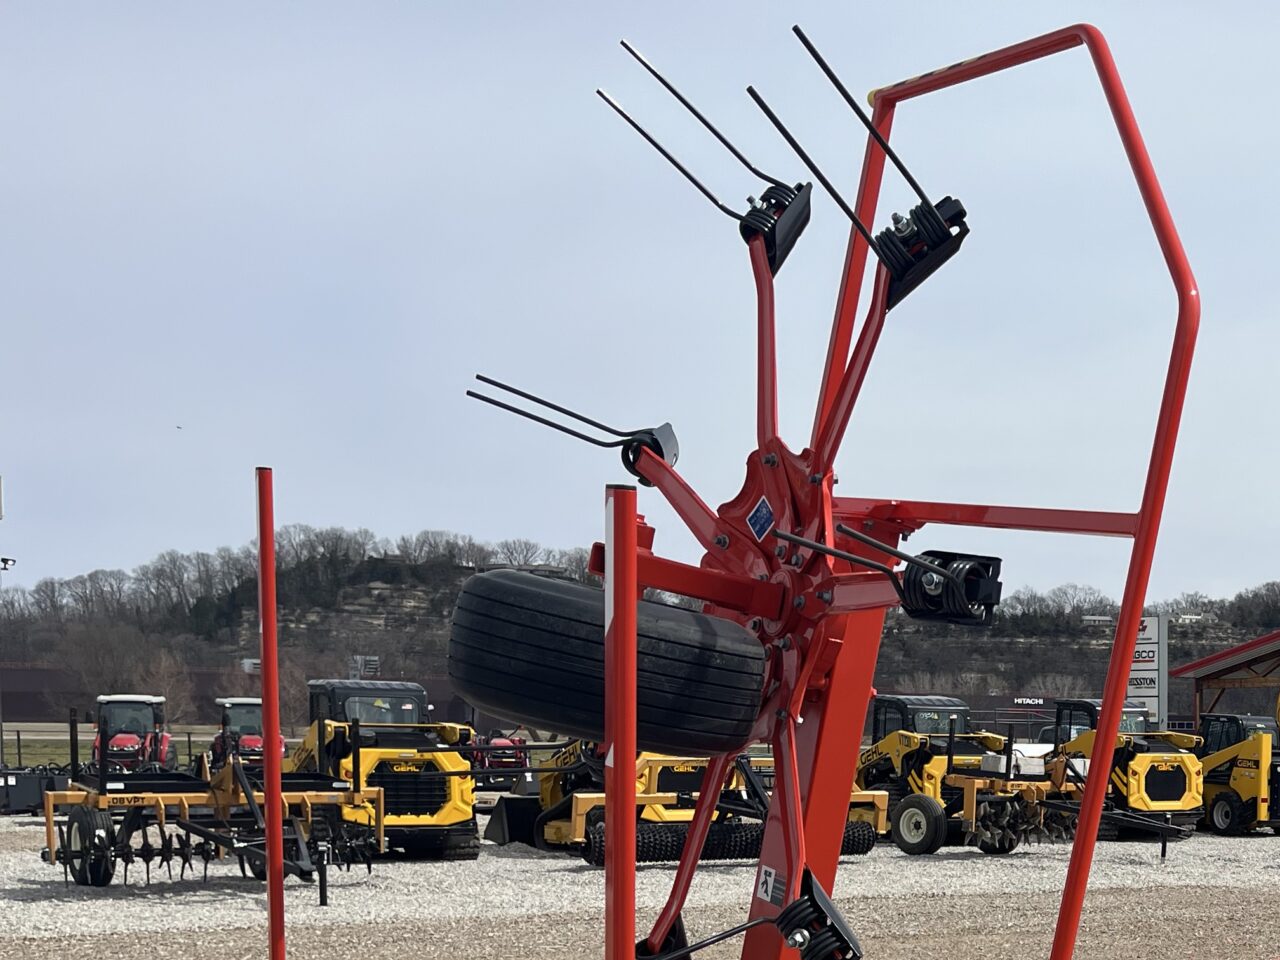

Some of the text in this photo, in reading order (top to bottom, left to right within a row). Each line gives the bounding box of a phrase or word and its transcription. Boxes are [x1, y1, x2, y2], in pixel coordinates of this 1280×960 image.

[1133, 650, 1155, 659] GCO
[1014, 697, 1044, 705] HITACHI
[860, 745, 882, 765] GEHL
[393, 764, 419, 772] GEHL
[1237, 759, 1257, 769] GEHL
[674, 765, 695, 773] GEHL
